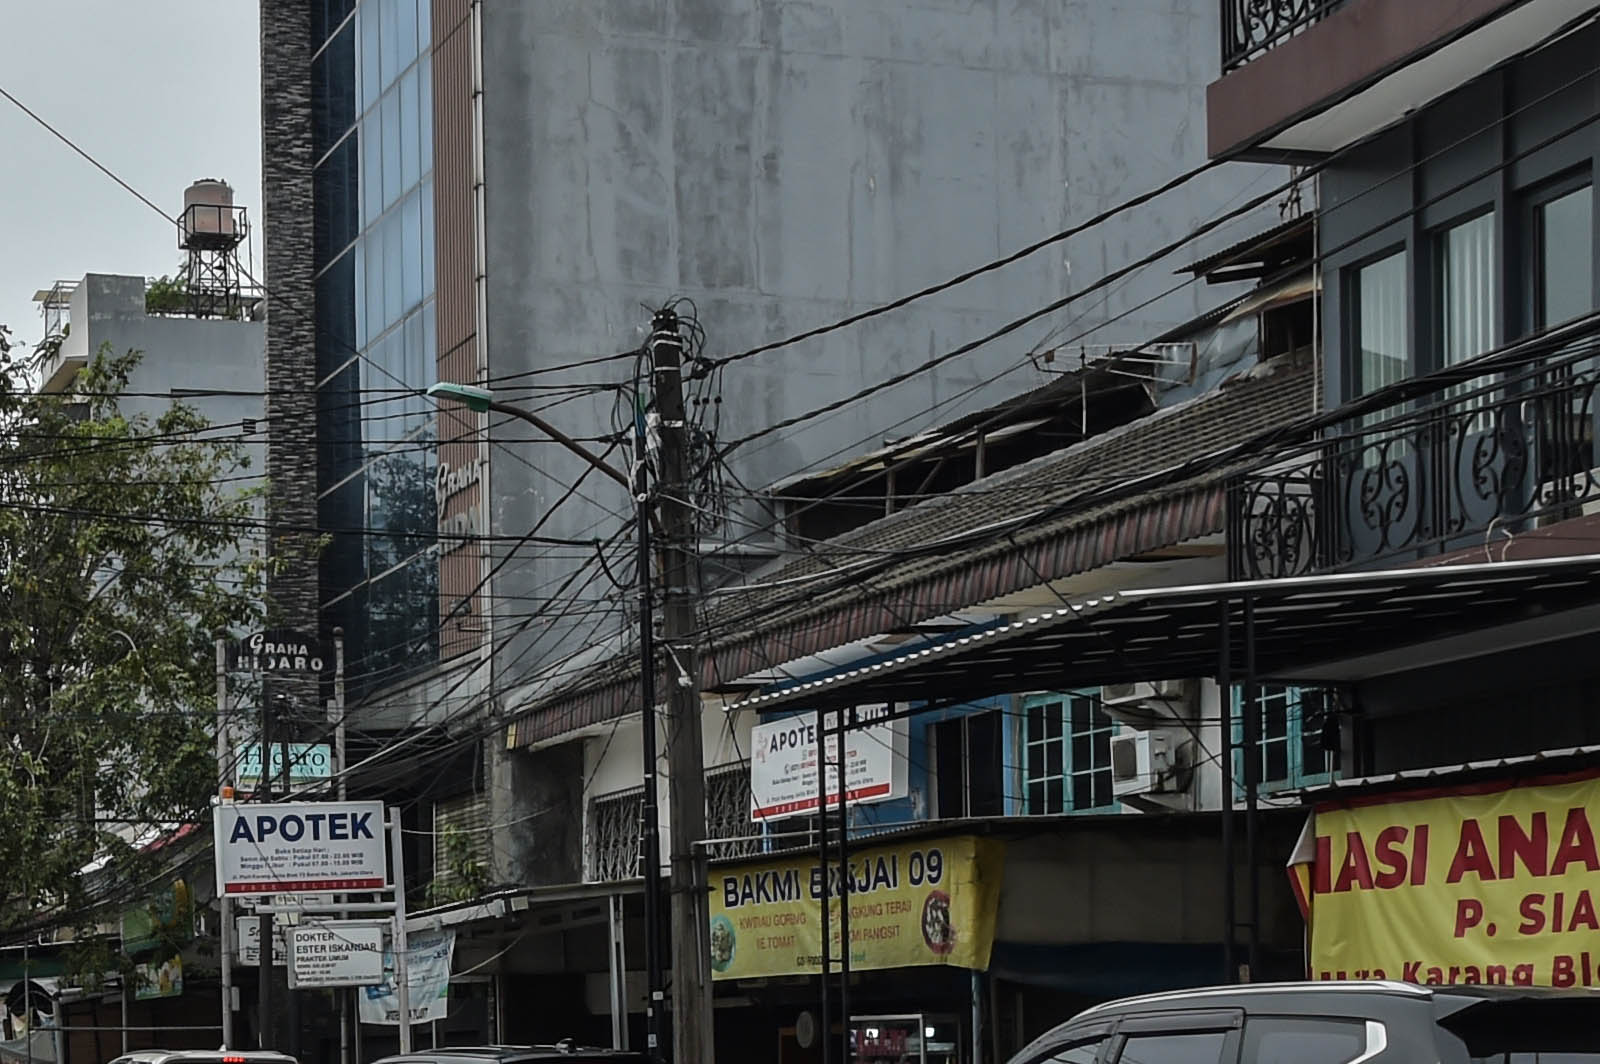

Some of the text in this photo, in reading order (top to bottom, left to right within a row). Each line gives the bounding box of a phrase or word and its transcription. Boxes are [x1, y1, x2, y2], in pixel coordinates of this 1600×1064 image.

[250, 634, 309, 655] GRAHA
[769, 722, 818, 753] APOTE
[229, 812, 373, 844] APOTEK
[723, 869, 801, 908] BAKMI
[909, 849, 943, 885] 09
[1454, 899, 1497, 938] P.
[296, 932, 335, 942] DOKTER
[296, 944, 327, 954] ESTER
[1402, 959, 1534, 987] Karang
